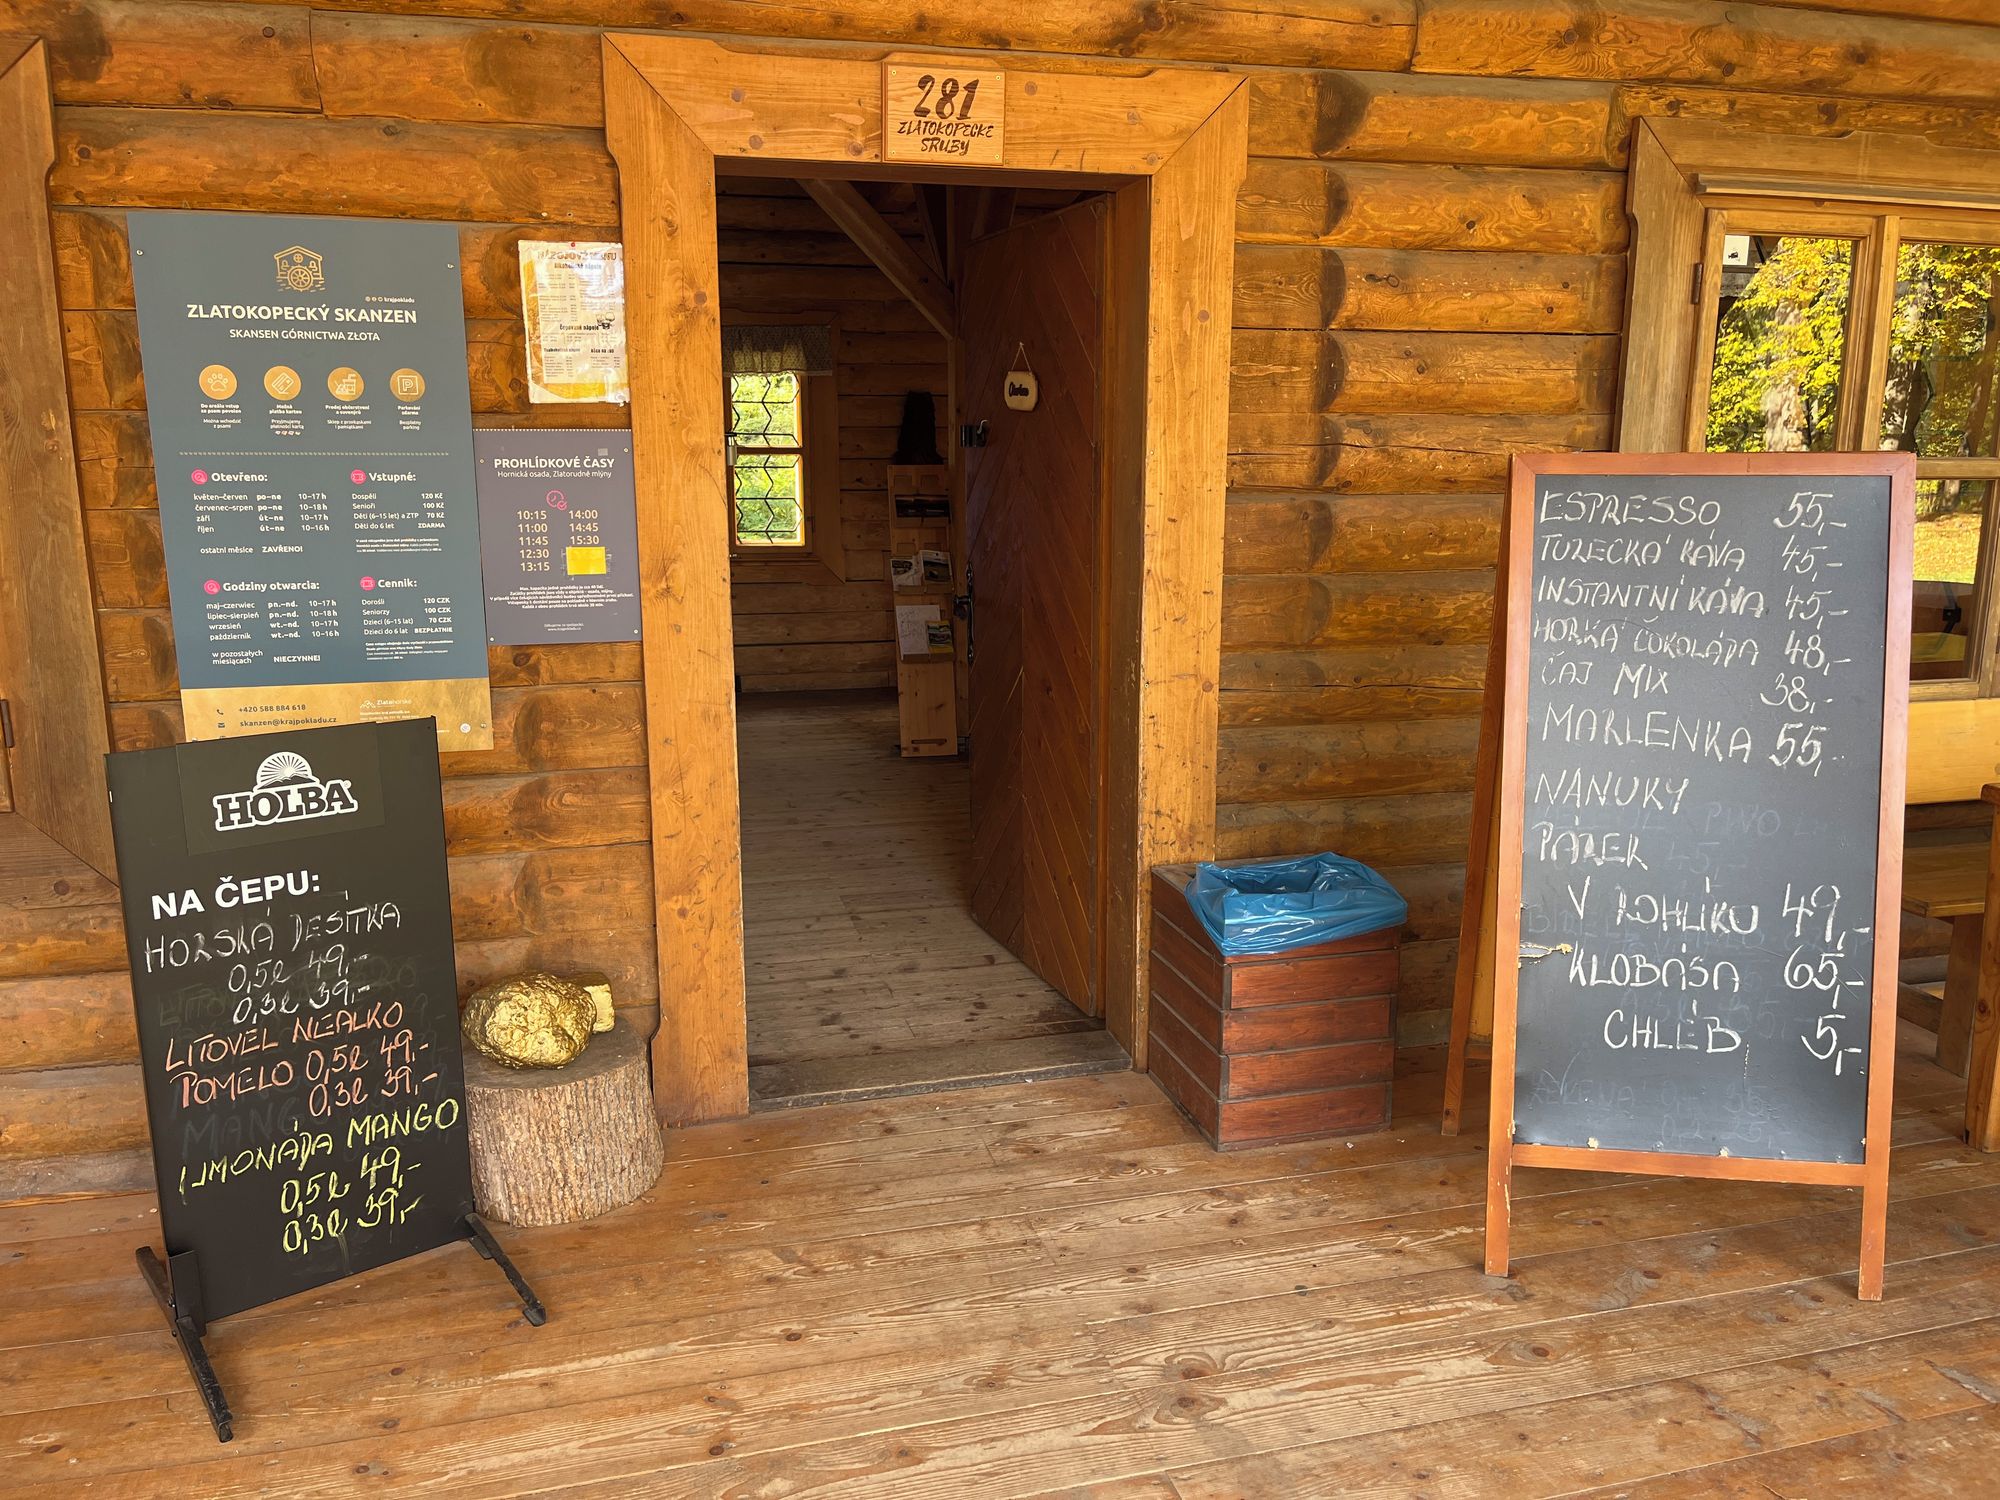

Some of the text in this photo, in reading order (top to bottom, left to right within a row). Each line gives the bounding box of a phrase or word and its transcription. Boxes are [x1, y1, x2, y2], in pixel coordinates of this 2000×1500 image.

[913, 74, 980, 120] 281
[920, 136, 970, 156] SRUBY
[187, 303, 417, 324] ZLATOKOPECKÝ SKANZEN
[229, 328, 380, 342] SKANSEN GÓRNICTWA ZŁOTA
[211, 471, 268, 482] Otevřeno:
[369, 471, 416, 483] Vstupné:
[494, 456, 615, 468] PROHLÍDKOVÉ ČASY
[498, 470, 528, 478] Hornická
[529, 470, 552, 478] osada,
[517, 510, 598, 520] 10:15 14:00
[518, 522, 599, 533] 11:00 14:45
[1539, 490, 1847, 536] ESPRESSO 55,-
[519, 536, 600, 546] 11:45 15:30
[520, 550, 550, 559] 12:30
[1680, 528, 1745, 572] KÁVA
[1781, 534, 1843, 582] 45,-
[223, 580, 320, 592] Godziny otwarcia:
[378, 578, 417, 588] Cennik:
[520, 562, 550, 572] 13:15
[1538, 574, 1849, 630] INSTANTNÍ KÁVA 45,-
[210, 632, 252, 641] październik
[220, 650, 264, 659] pozostałych
[1533, 613, 1851, 676] HORKÁ ČOKOLÁDA 48,-
[212, 658, 252, 666] miesiącach
[1541, 650, 1833, 714] ČAJ MIX 38,-
[240, 717, 337, 727] skanzen@krajpokladu.cz
[1542, 702, 1845, 777] MARLENKA 55,-
[213, 780, 358, 831] HOLBA
[1531, 815, 1648, 871] PÁREK
[151, 870, 320, 920] NA ČEPU:
[1567, 875, 1592, 920] V
[1615, 876, 1759, 933] ROHLÍKU
[1782, 883, 1871, 950] 49,-
[145, 906, 274, 973] HORSKÁ
[228, 943, 369, 994] 0,5l 49,-
[1569, 940, 1866, 1010] KLOBÁSA 65,-
[233, 990, 299, 1025] 0,3l
[309, 978, 371, 1009] 39,-
[165, 1001, 403, 1072] LITOVEL NEALKO
[1603, 999, 1863, 1076] CHLÉB 5,-
[170, 1028, 429, 1108] POMELO 0,5l 49,-
[309, 1065, 438, 1116] 0,3l 39,-
[178, 1116, 333, 1196] LIMONÁDA
[347, 1098, 459, 1148] MANGO
[280, 1146, 422, 1218] 0,5l 49,-
[282, 1187, 425, 1254] 0,3l 39,-
